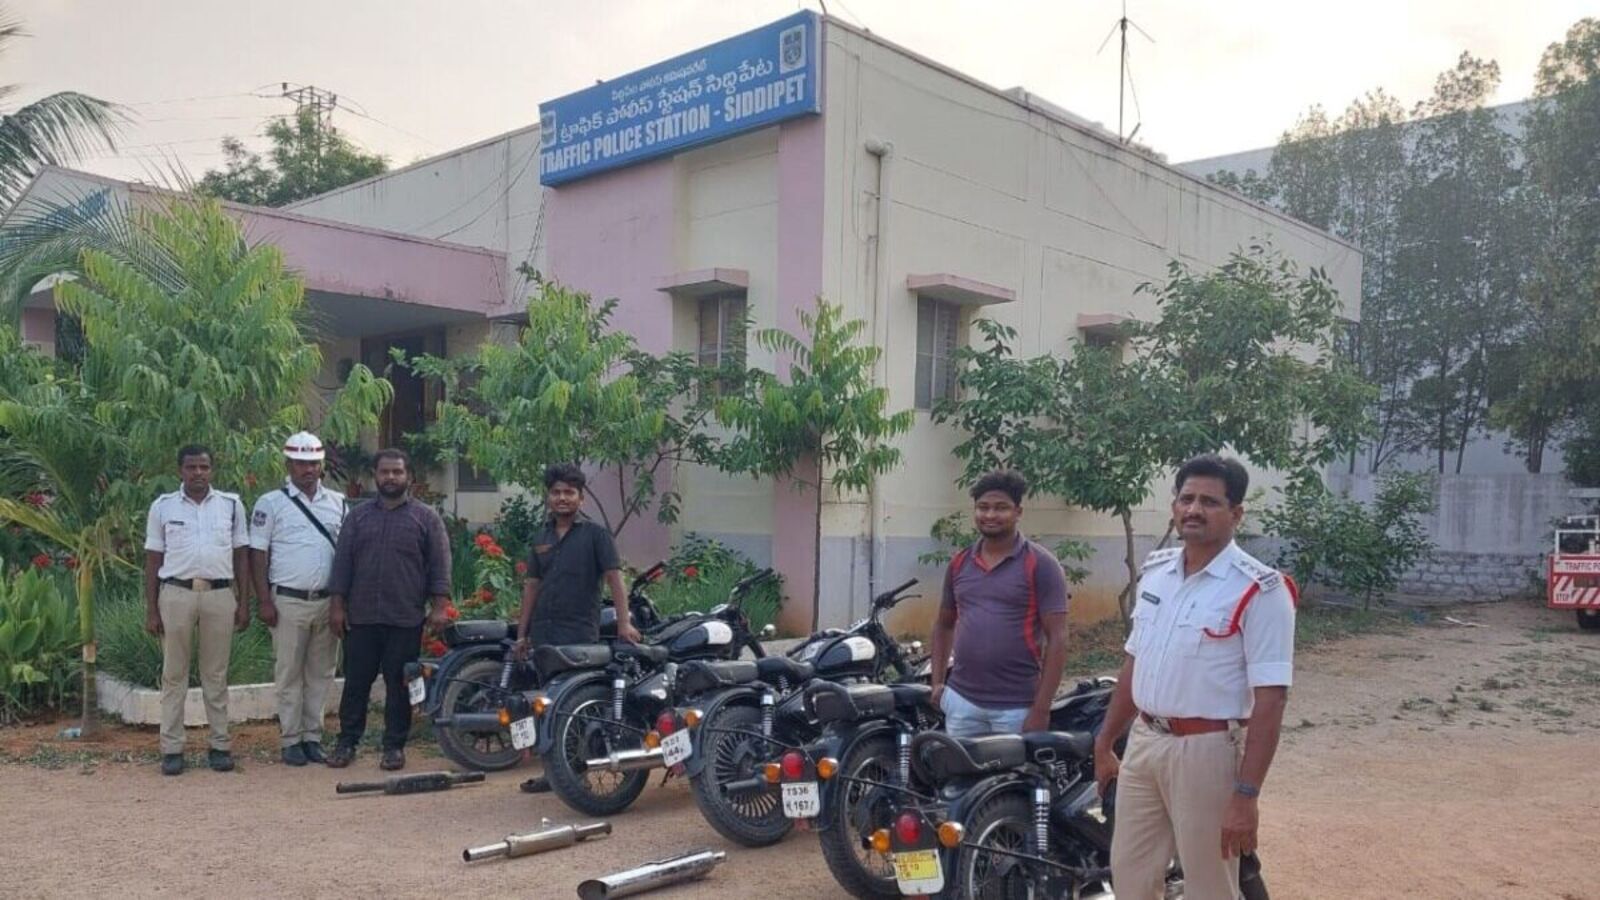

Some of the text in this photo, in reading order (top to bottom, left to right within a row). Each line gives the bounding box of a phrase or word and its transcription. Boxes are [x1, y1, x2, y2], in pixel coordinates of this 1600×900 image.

[541, 140, 591, 175] TRAFFIC
[594, 125, 642, 160] POLICE
[646, 104, 710, 146] STATION
[724, 74, 806, 121] SIDDIPET
